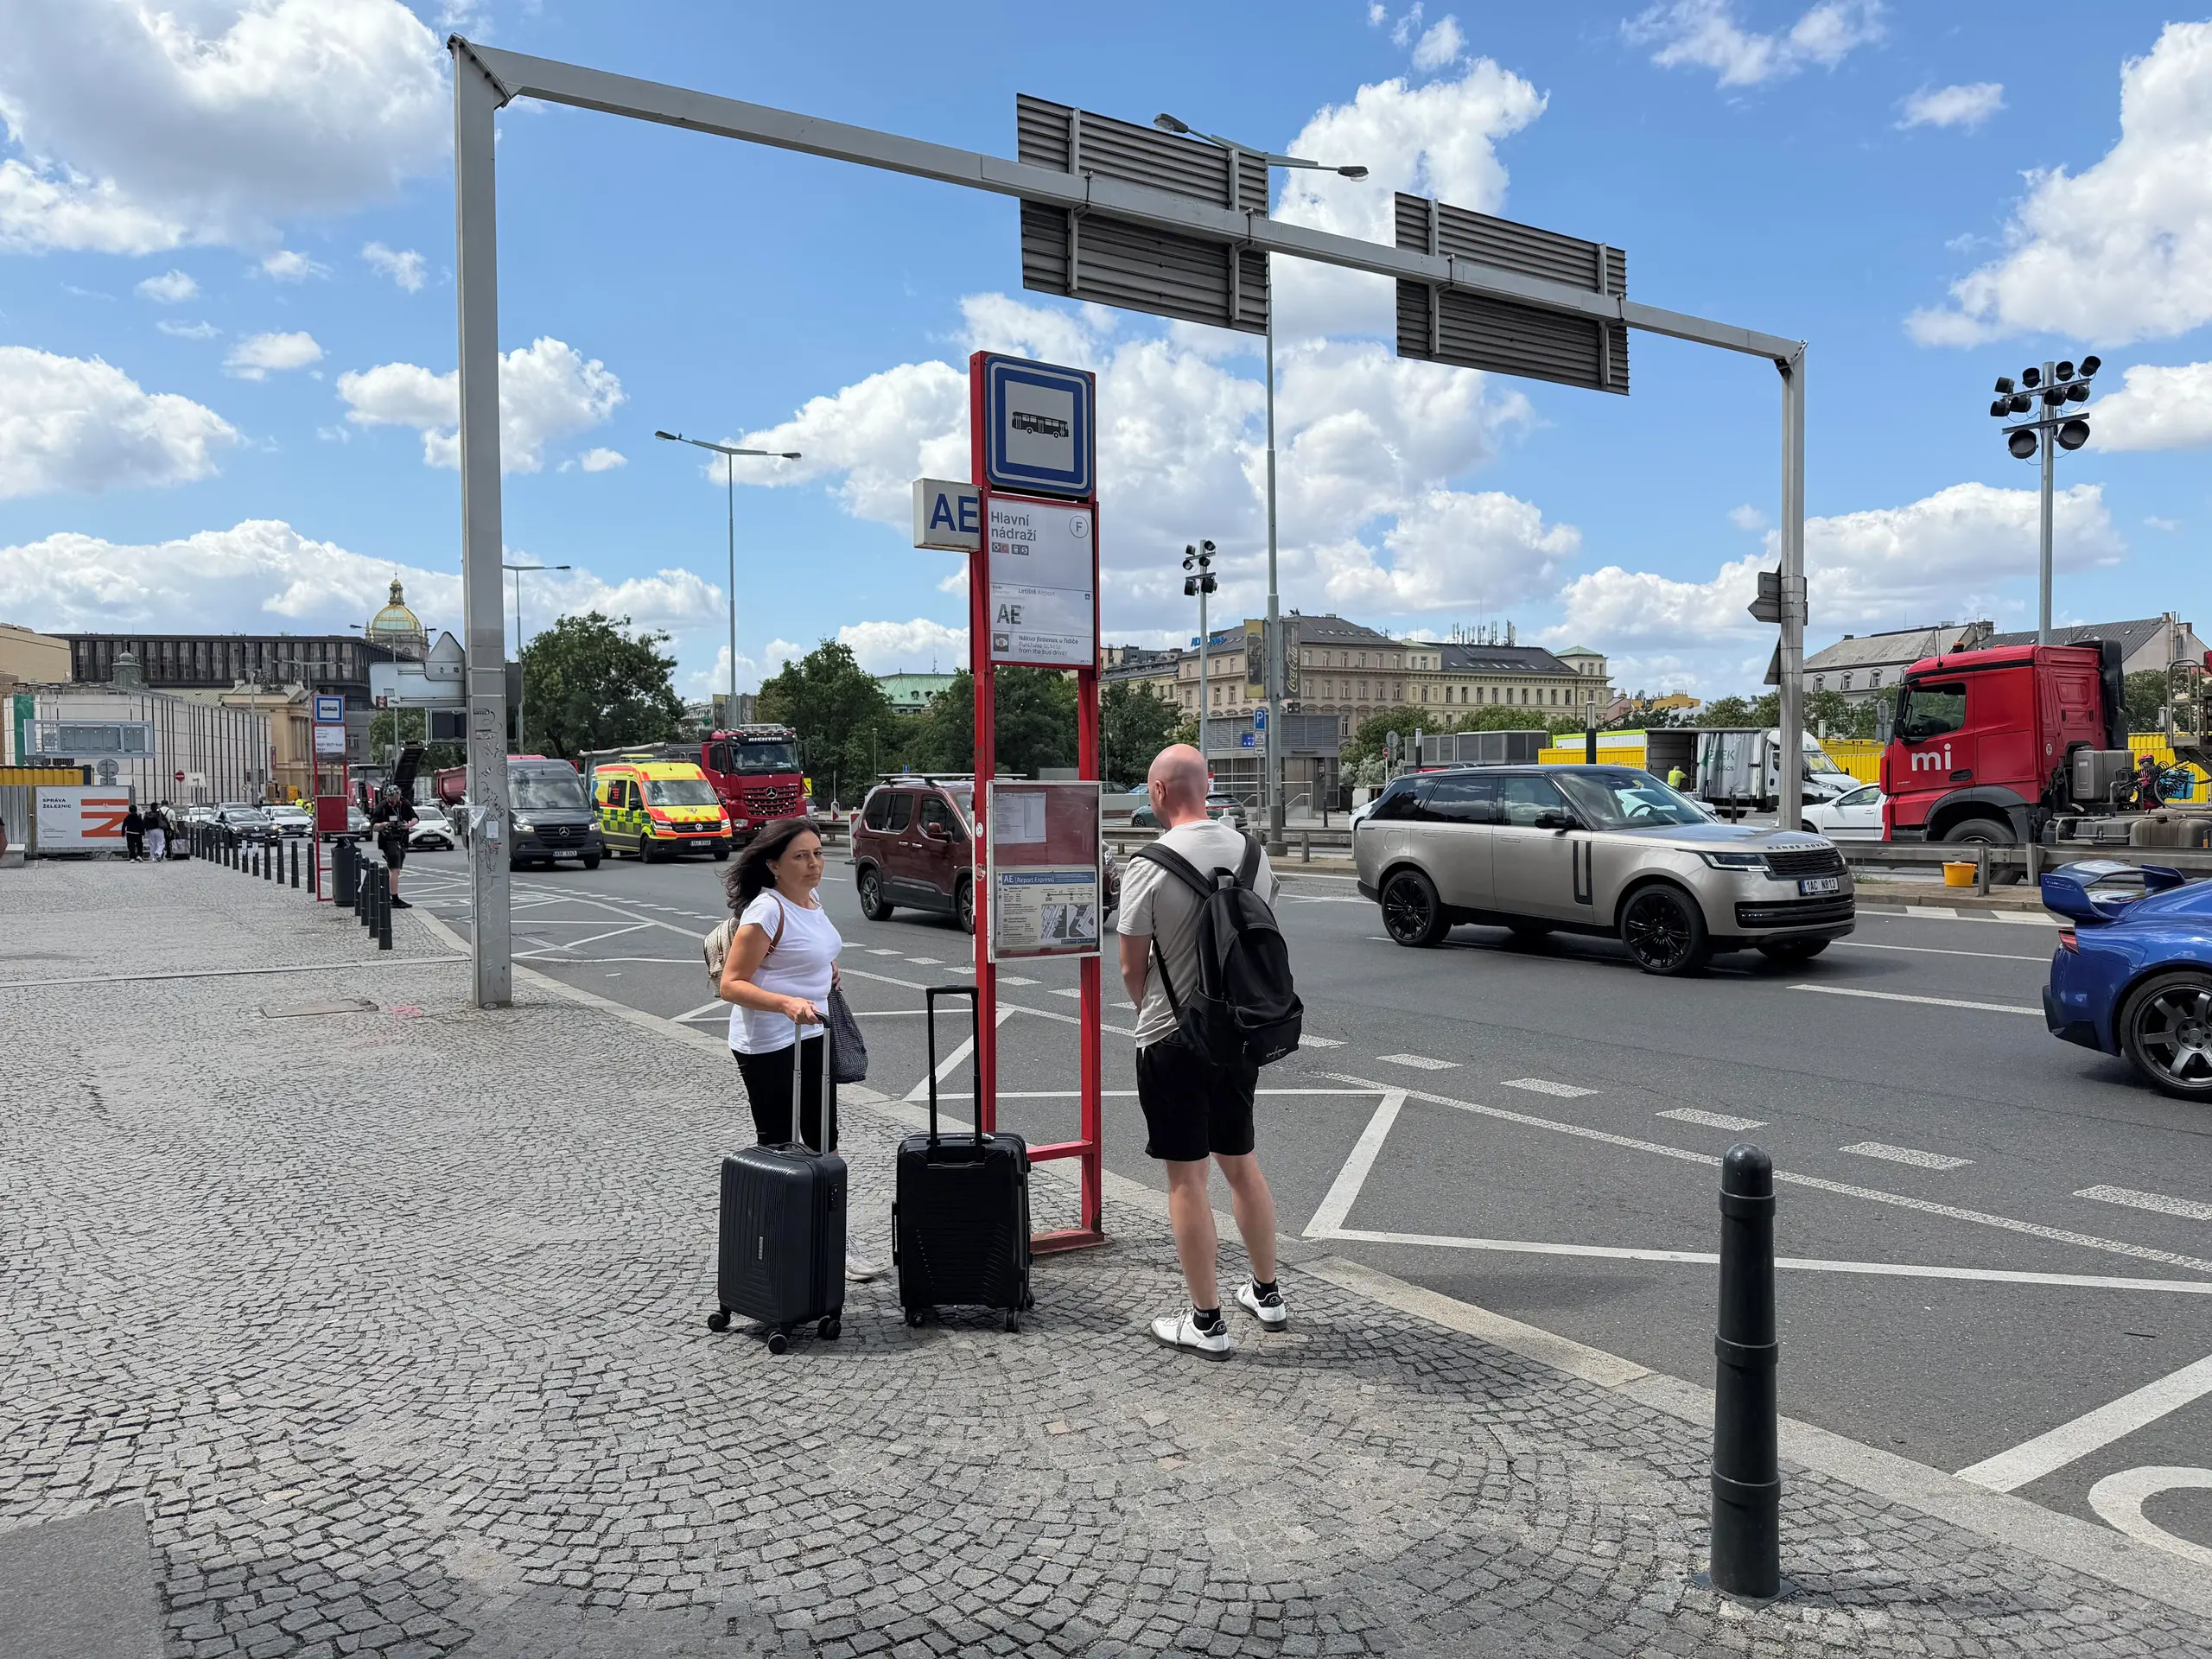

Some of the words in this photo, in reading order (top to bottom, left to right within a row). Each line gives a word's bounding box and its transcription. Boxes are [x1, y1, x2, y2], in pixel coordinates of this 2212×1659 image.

[930, 493, 979, 533] AE
[991, 512, 1029, 526] Hlavní
[991, 526, 1037, 542] nádraží
[1076, 522, 1083, 532] F
[996, 604, 1021, 625] AE
[1256, 711, 1263, 724] P
[1911, 743, 1952, 772] mi
[1806, 880, 1819, 891] 1AC
[1821, 879, 1836, 889] N813
